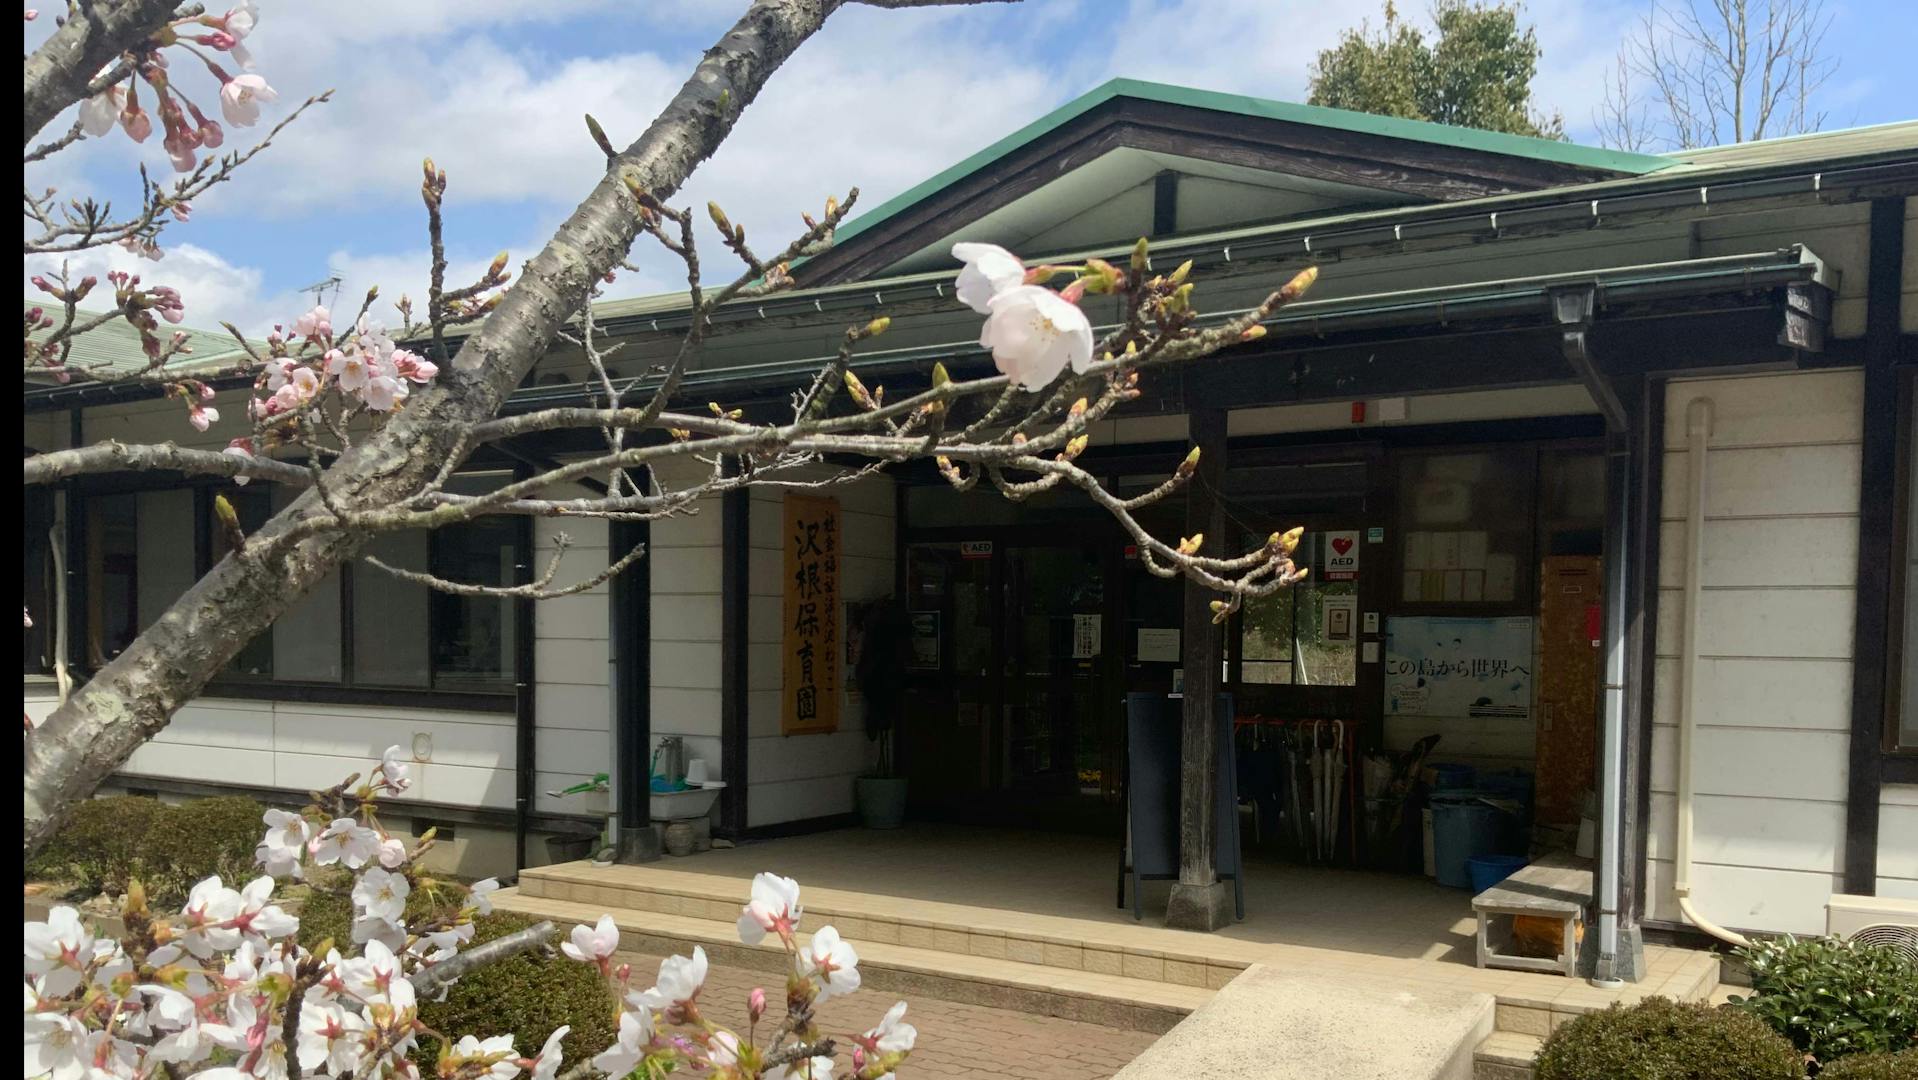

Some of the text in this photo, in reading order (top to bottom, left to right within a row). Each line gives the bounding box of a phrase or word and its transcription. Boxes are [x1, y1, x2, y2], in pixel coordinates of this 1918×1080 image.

[971, 543, 991, 552] AED
[1330, 557, 1354, 566] AED
[795, 519, 824, 721] 沢根保育園
[1385, 657, 1530, 679] この島から世界へ
